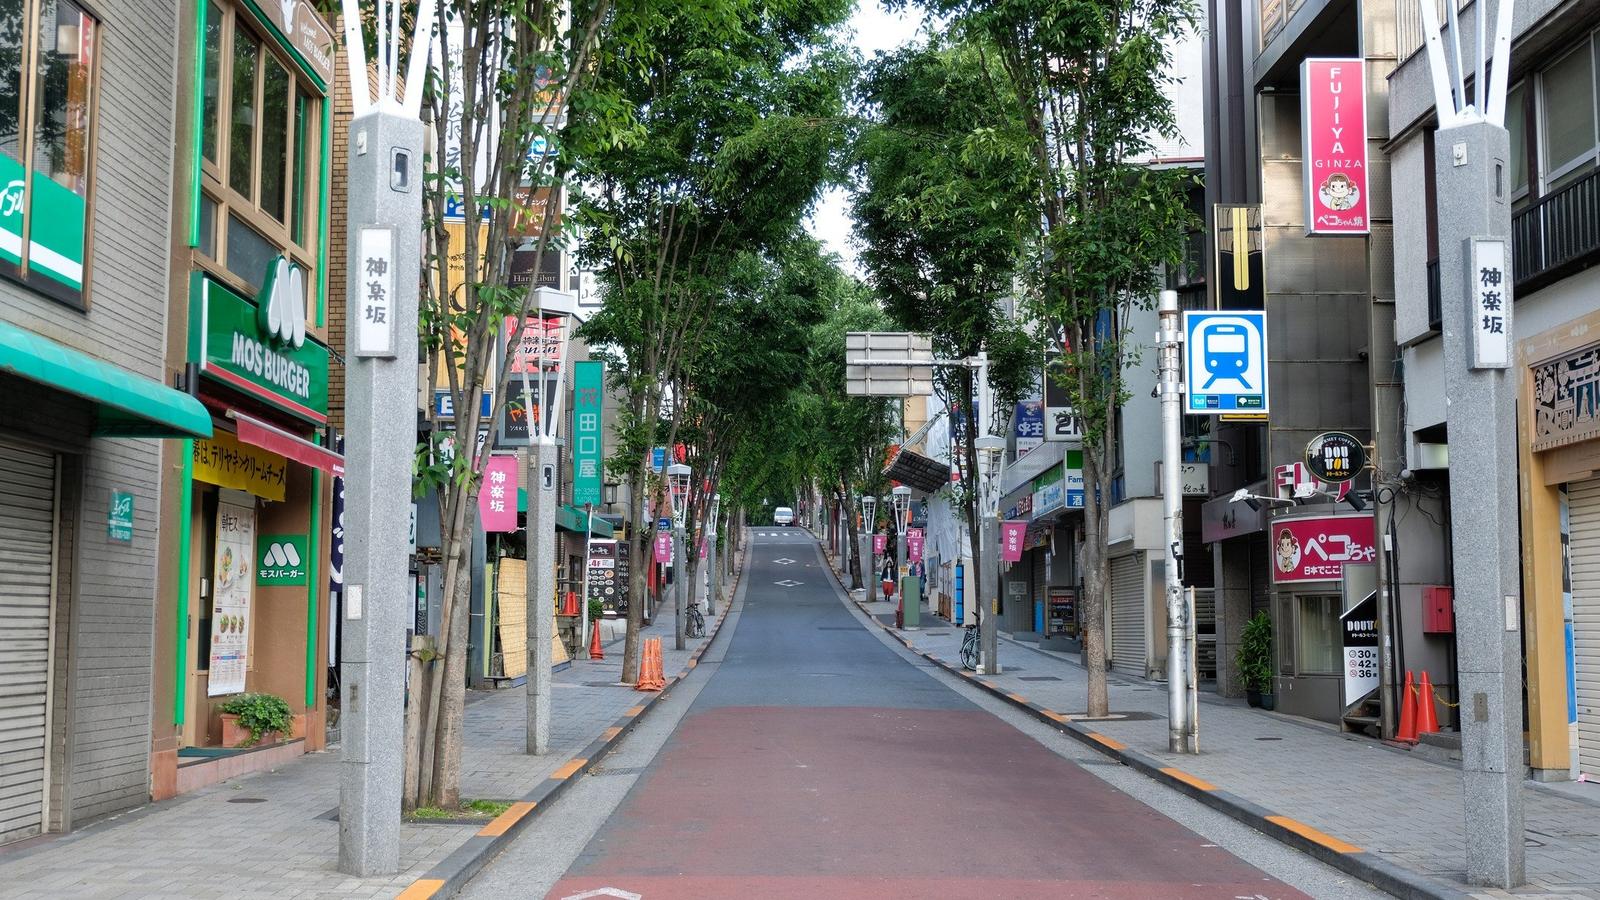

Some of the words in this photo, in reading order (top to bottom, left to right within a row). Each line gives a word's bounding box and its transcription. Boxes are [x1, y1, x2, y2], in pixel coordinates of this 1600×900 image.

[1330, 67, 1344, 154] FUJIYA
[1315, 159, 1363, 168] GINZA
[1317, 215, 1364, 227] ペコちゃん焼
[365, 257, 388, 324] 神楽坂
[1480, 267, 1504, 334] 神楽坂
[232, 331, 263, 377] MOS
[264, 348, 310, 400] BURGER
[1325, 446, 1349, 458] DOU
[1325, 458, 1349, 470] TOR
[490, 471, 506, 513] 神楽坂
[1072, 495, 1083, 506] 酒
[1304, 533, 1375, 562] ペコちゃ
[260, 569, 304, 578] モスバーガー
[1304, 565, 1343, 576] 日本でここ
